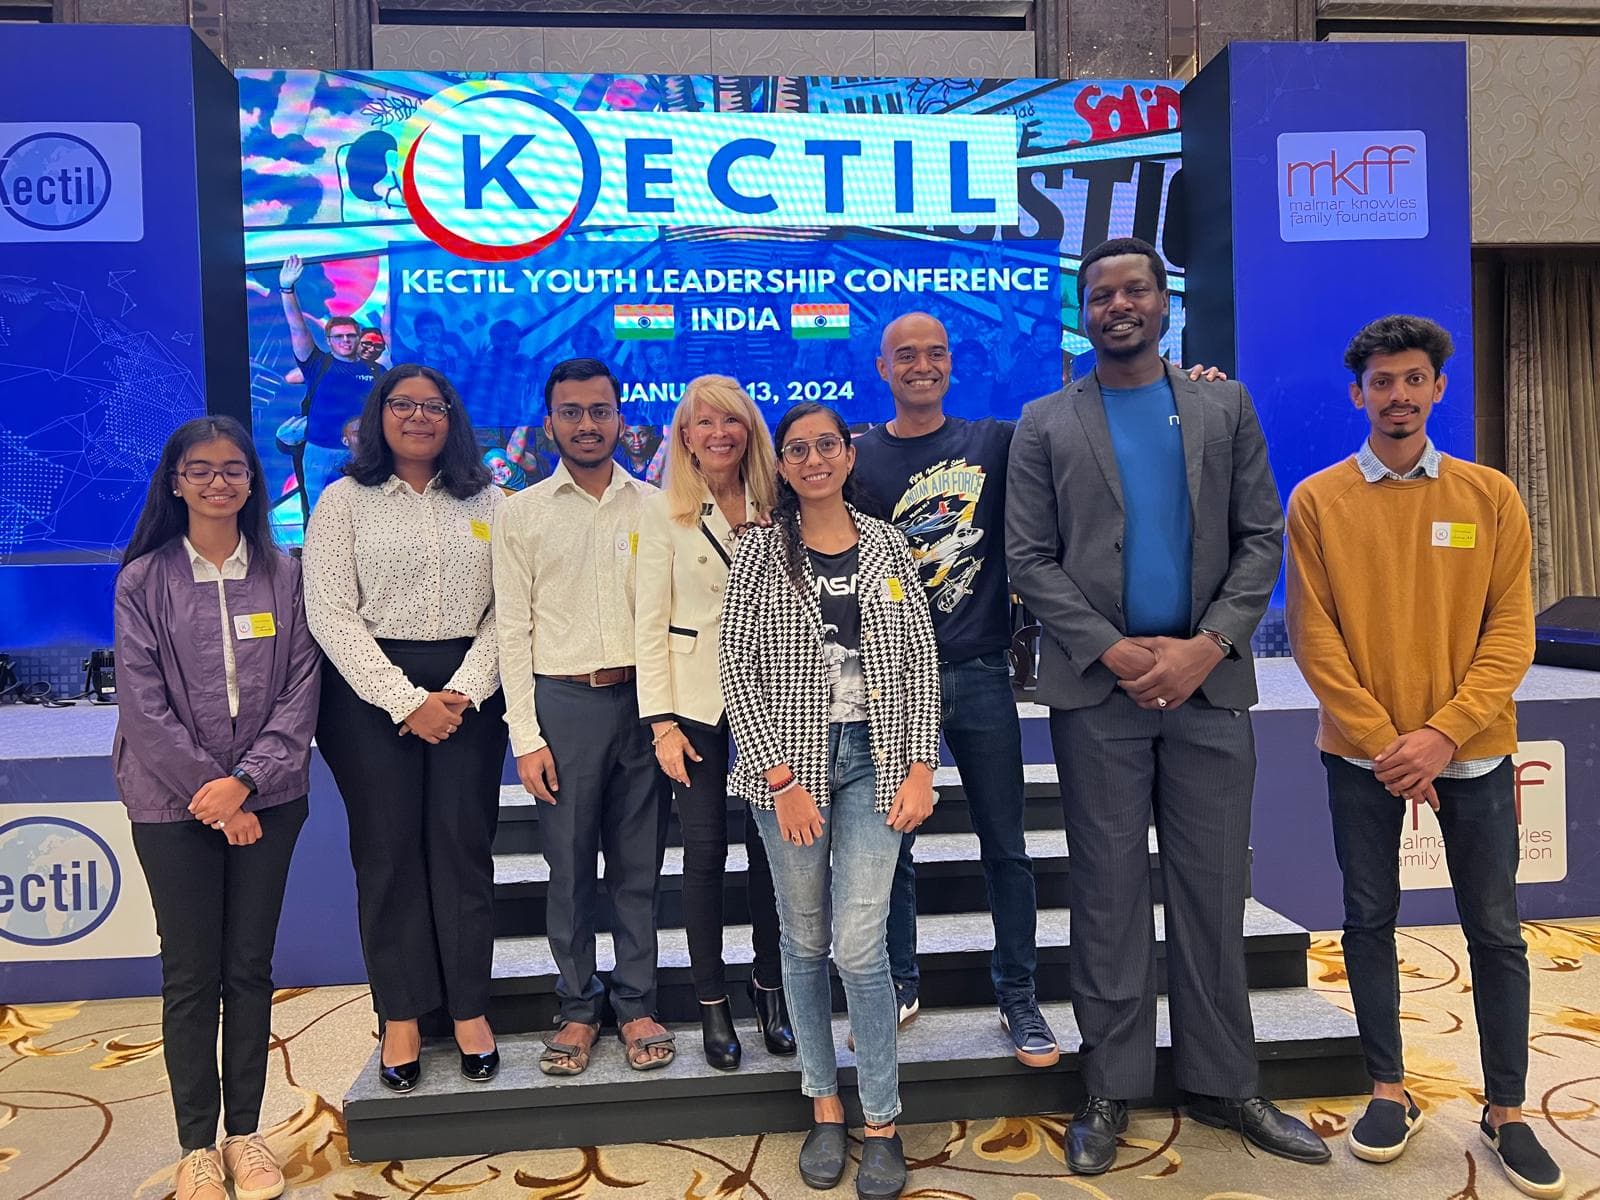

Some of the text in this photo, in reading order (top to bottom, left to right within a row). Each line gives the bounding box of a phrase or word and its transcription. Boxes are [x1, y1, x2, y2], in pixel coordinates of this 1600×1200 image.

[463, 134, 997, 214] KECTIL
[1287, 145, 1416, 197] mkff
[1289, 197, 1417, 211] malmar knowles
[1290, 210, 1417, 227] family foundation
[401, 267, 1049, 294] KECTIL YOUTH LEADERSHIP CONFERENCE
[691, 306, 781, 332] INDIA
[620, 380, 854, 405] JANU 13, 2024
[904, 471, 982, 506] INDIAN AIR FORCE
[1399, 833, 1446, 850] alma
[1399, 850, 1441, 870] mily
[0, 860, 98, 913] ectil
